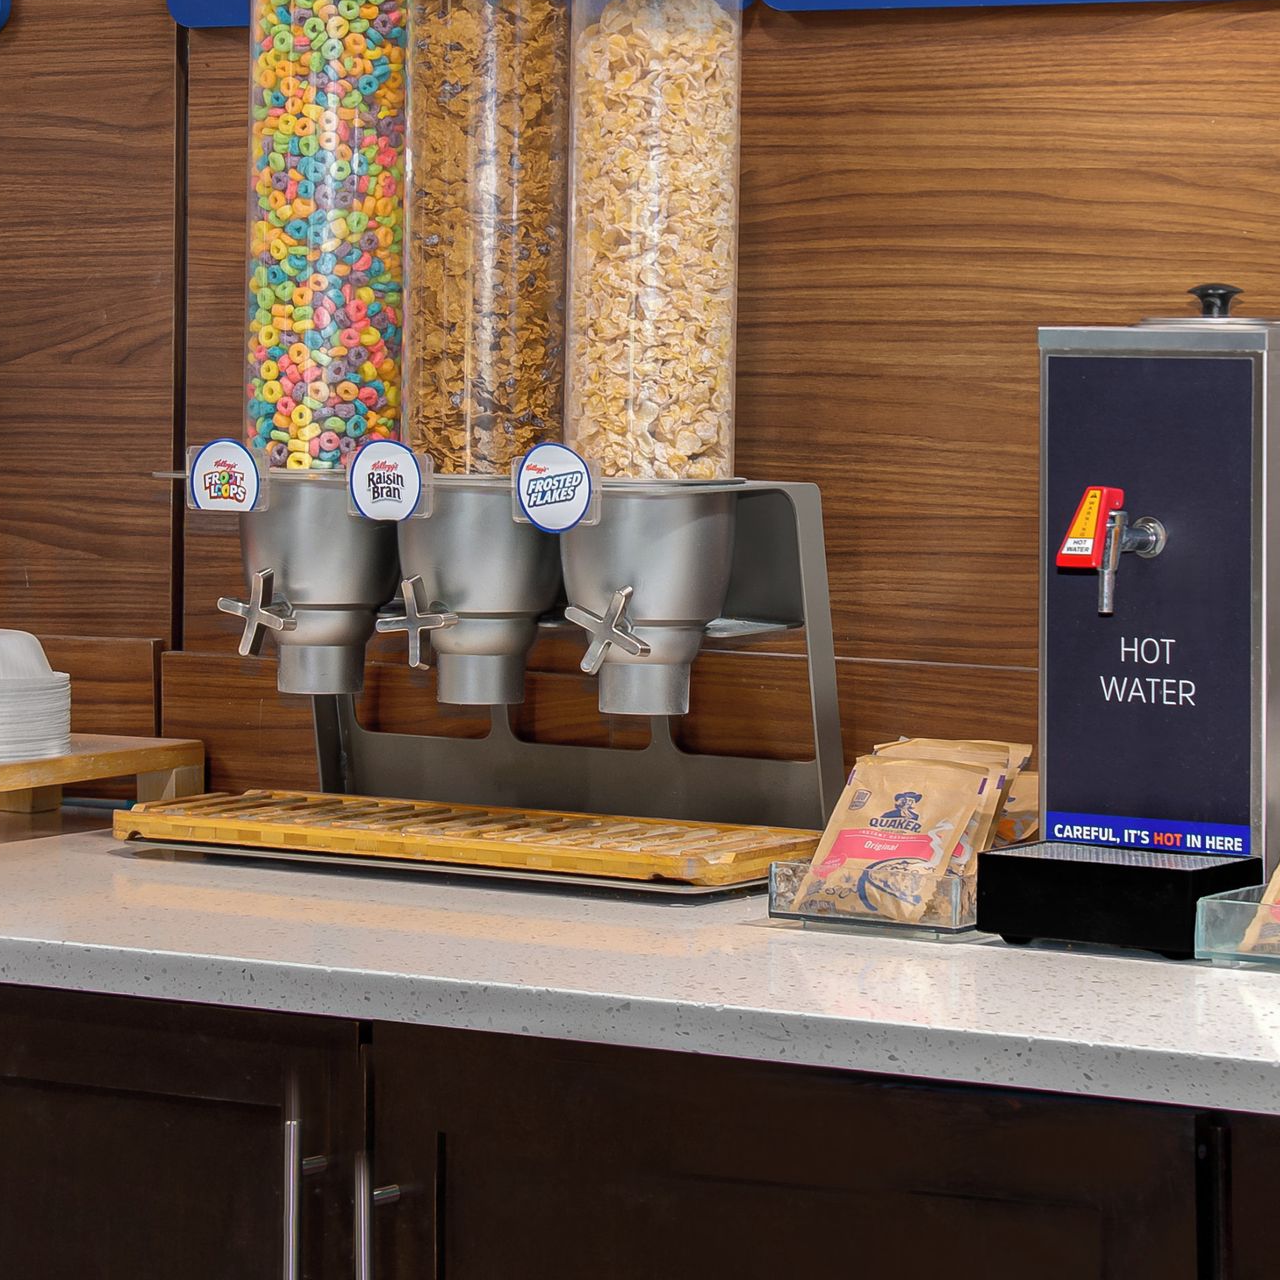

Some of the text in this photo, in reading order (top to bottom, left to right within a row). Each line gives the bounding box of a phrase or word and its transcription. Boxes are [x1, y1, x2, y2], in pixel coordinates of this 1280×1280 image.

[204, 470, 244, 490] FROOT
[367, 471, 405, 488] Raisin
[527, 471, 583, 495] FROSTED
[372, 485, 402, 500] Bran
[528, 486, 575, 507] FLAKES
[1121, 637, 1176, 665] HOT
[1100, 676, 1196, 706] WATER
[869, 817, 922, 834] QUAKER
[864, 840, 899, 852] Original
[1054, 824, 1243, 852] CAREFUL, IT'S HOT IN HERE
